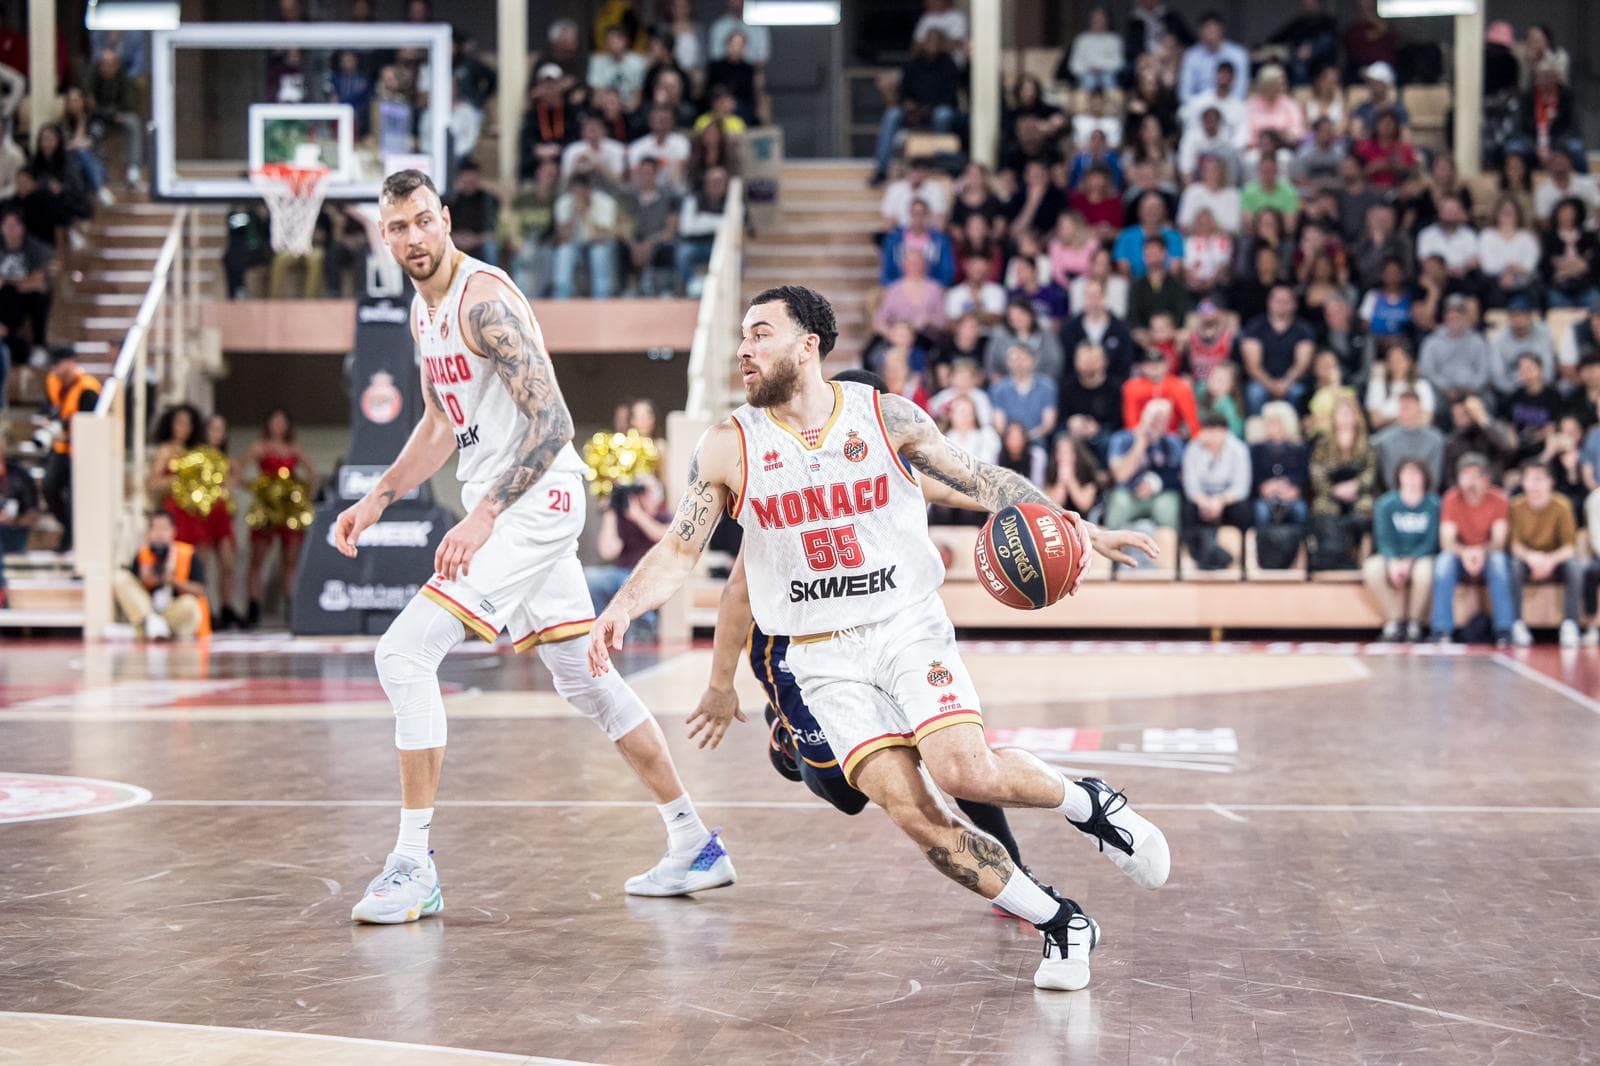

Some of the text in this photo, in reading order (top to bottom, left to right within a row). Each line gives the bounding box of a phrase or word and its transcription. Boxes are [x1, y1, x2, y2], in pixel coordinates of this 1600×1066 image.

[763, 461, 784, 472] errea
[549, 489, 570, 512] 20
[750, 473, 890, 530] MONACO
[800, 523, 865, 572] 55
[1000, 514, 1039, 583] SPALDING
[1036, 515, 1064, 550] LNB
[790, 564, 898, 603] SKWEEK
[976, 531, 1005, 592] Betclic
